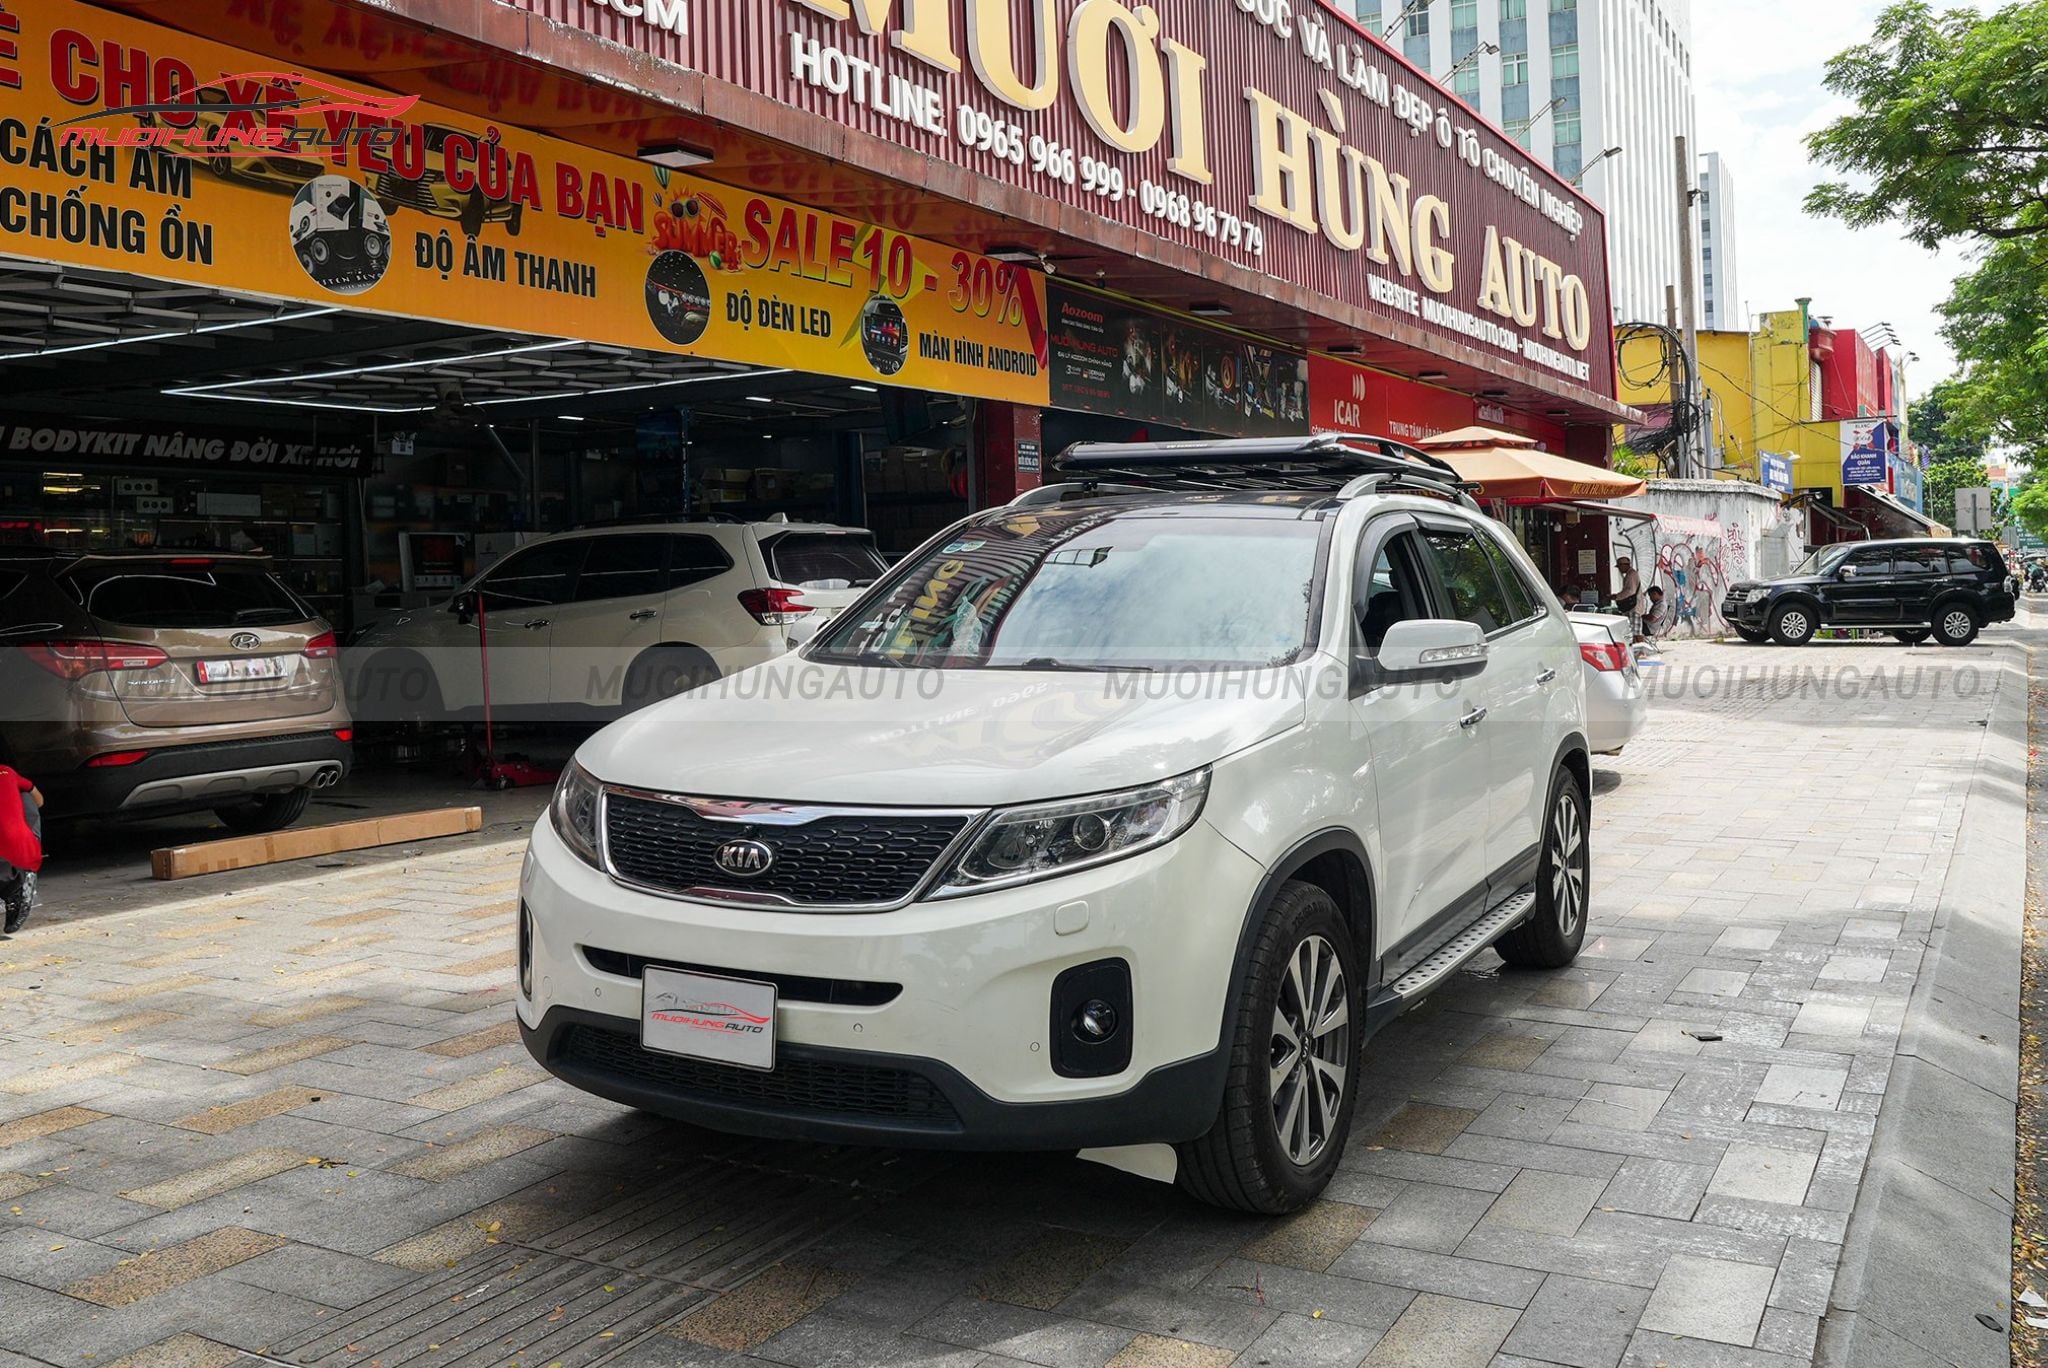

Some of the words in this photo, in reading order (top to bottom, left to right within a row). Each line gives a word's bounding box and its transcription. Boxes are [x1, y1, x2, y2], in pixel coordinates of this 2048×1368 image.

[0, 117, 115, 184] CÁCH
[50, 28, 198, 127] CHO
[443, 125, 544, 211] CỦA
[555, 162, 644, 237] BẠN
[1297, 10, 1334, 71] VÀ
[1336, 44, 1389, 108] LÀM
[1392, 84, 1433, 137] ĐẸP
[1436, 107, 1452, 149] Ô
[1454, 126, 1480, 168] TÔ
[1482, 148, 1540, 209] CHUYÊN
[1540, 188, 1583, 241] NGHIỆP
[958, 105, 1025, 165] 0965
[1029, 135, 1076, 185] 966
[1080, 156, 1124, 201] 999
[1140, 180, 1191, 228] 0968
[1192, 201, 1217, 237] 96
[1217, 211, 1241, 246] 79
[1242, 221, 1263, 256] 79
[0, 185, 146, 254] CHỐNG
[160, 203, 213, 266] ỒN
[653, 210, 741, 273] SUMMER
[1244, 87, 1455, 293] HÙNG
[1478, 225, 1591, 351] AUTO
[415, 229, 453, 280] ĐỘ
[463, 233, 505, 282] ÂM
[514, 251, 595, 298] THANH
[741, 198, 853, 288] SALE
[864, 228, 912, 299] 10
[949, 251, 1022, 327] 30%
[726, 289, 752, 331] ĐỘ
[758, 294, 795, 332] ĐÈN
[800, 306, 831, 338] LED
[1061, 302, 1104, 324] Aozoom
[1367, 273, 1420, 318] WEBSITE
[919, 330, 949, 361] MÀN
[954, 336, 983, 368] HÌNH
[988, 346, 1037, 376] ANDROID
[1334, 399, 1360, 428] ICAR
[1389, 420, 1409, 437] TRUNG
[11, 427, 141, 455] BODYKIT
[143, 431, 224, 461] NÂNG
[229, 435, 278, 464] ĐỜI
[722, 845, 760, 869] KIA
